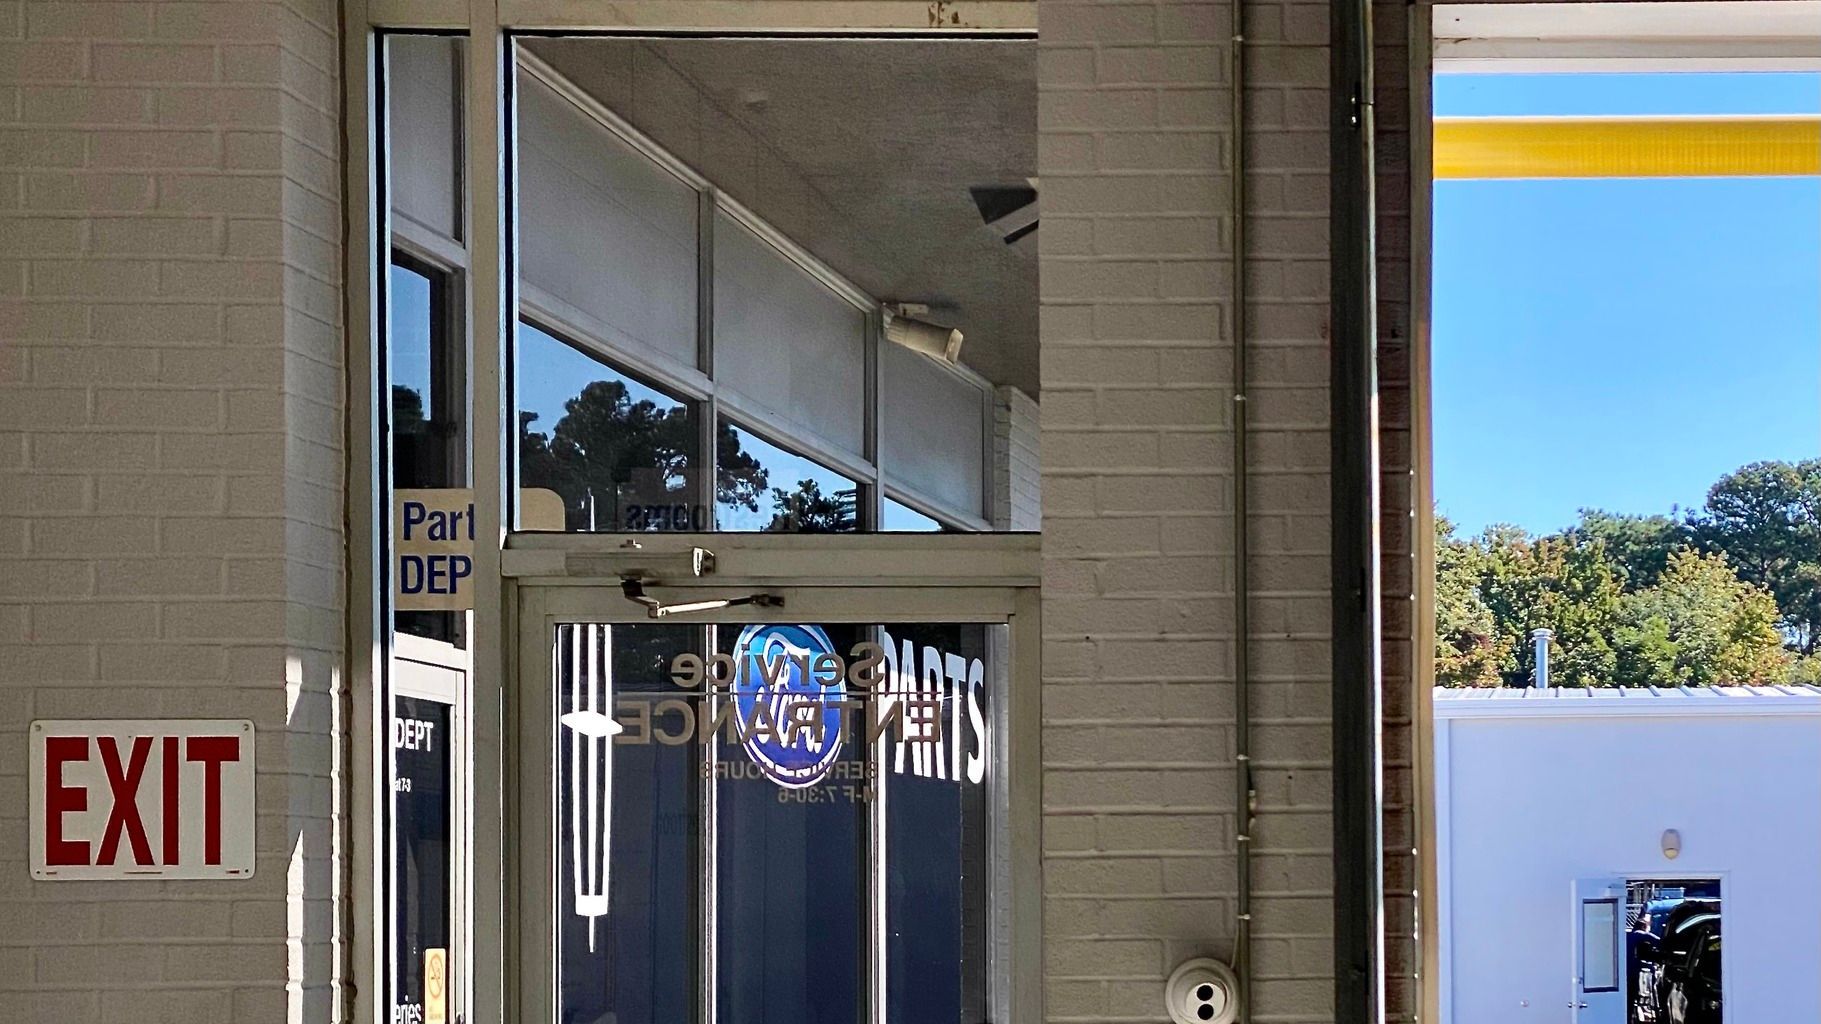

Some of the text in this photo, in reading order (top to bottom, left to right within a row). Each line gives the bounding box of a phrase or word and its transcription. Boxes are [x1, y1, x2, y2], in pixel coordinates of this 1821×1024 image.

[403, 502, 475, 541] Part
[400, 555, 472, 594] DEP
[879, 630, 985, 784] PARTS
[395, 718, 434, 752] DEPT
[46, 737, 239, 865] EXIT
